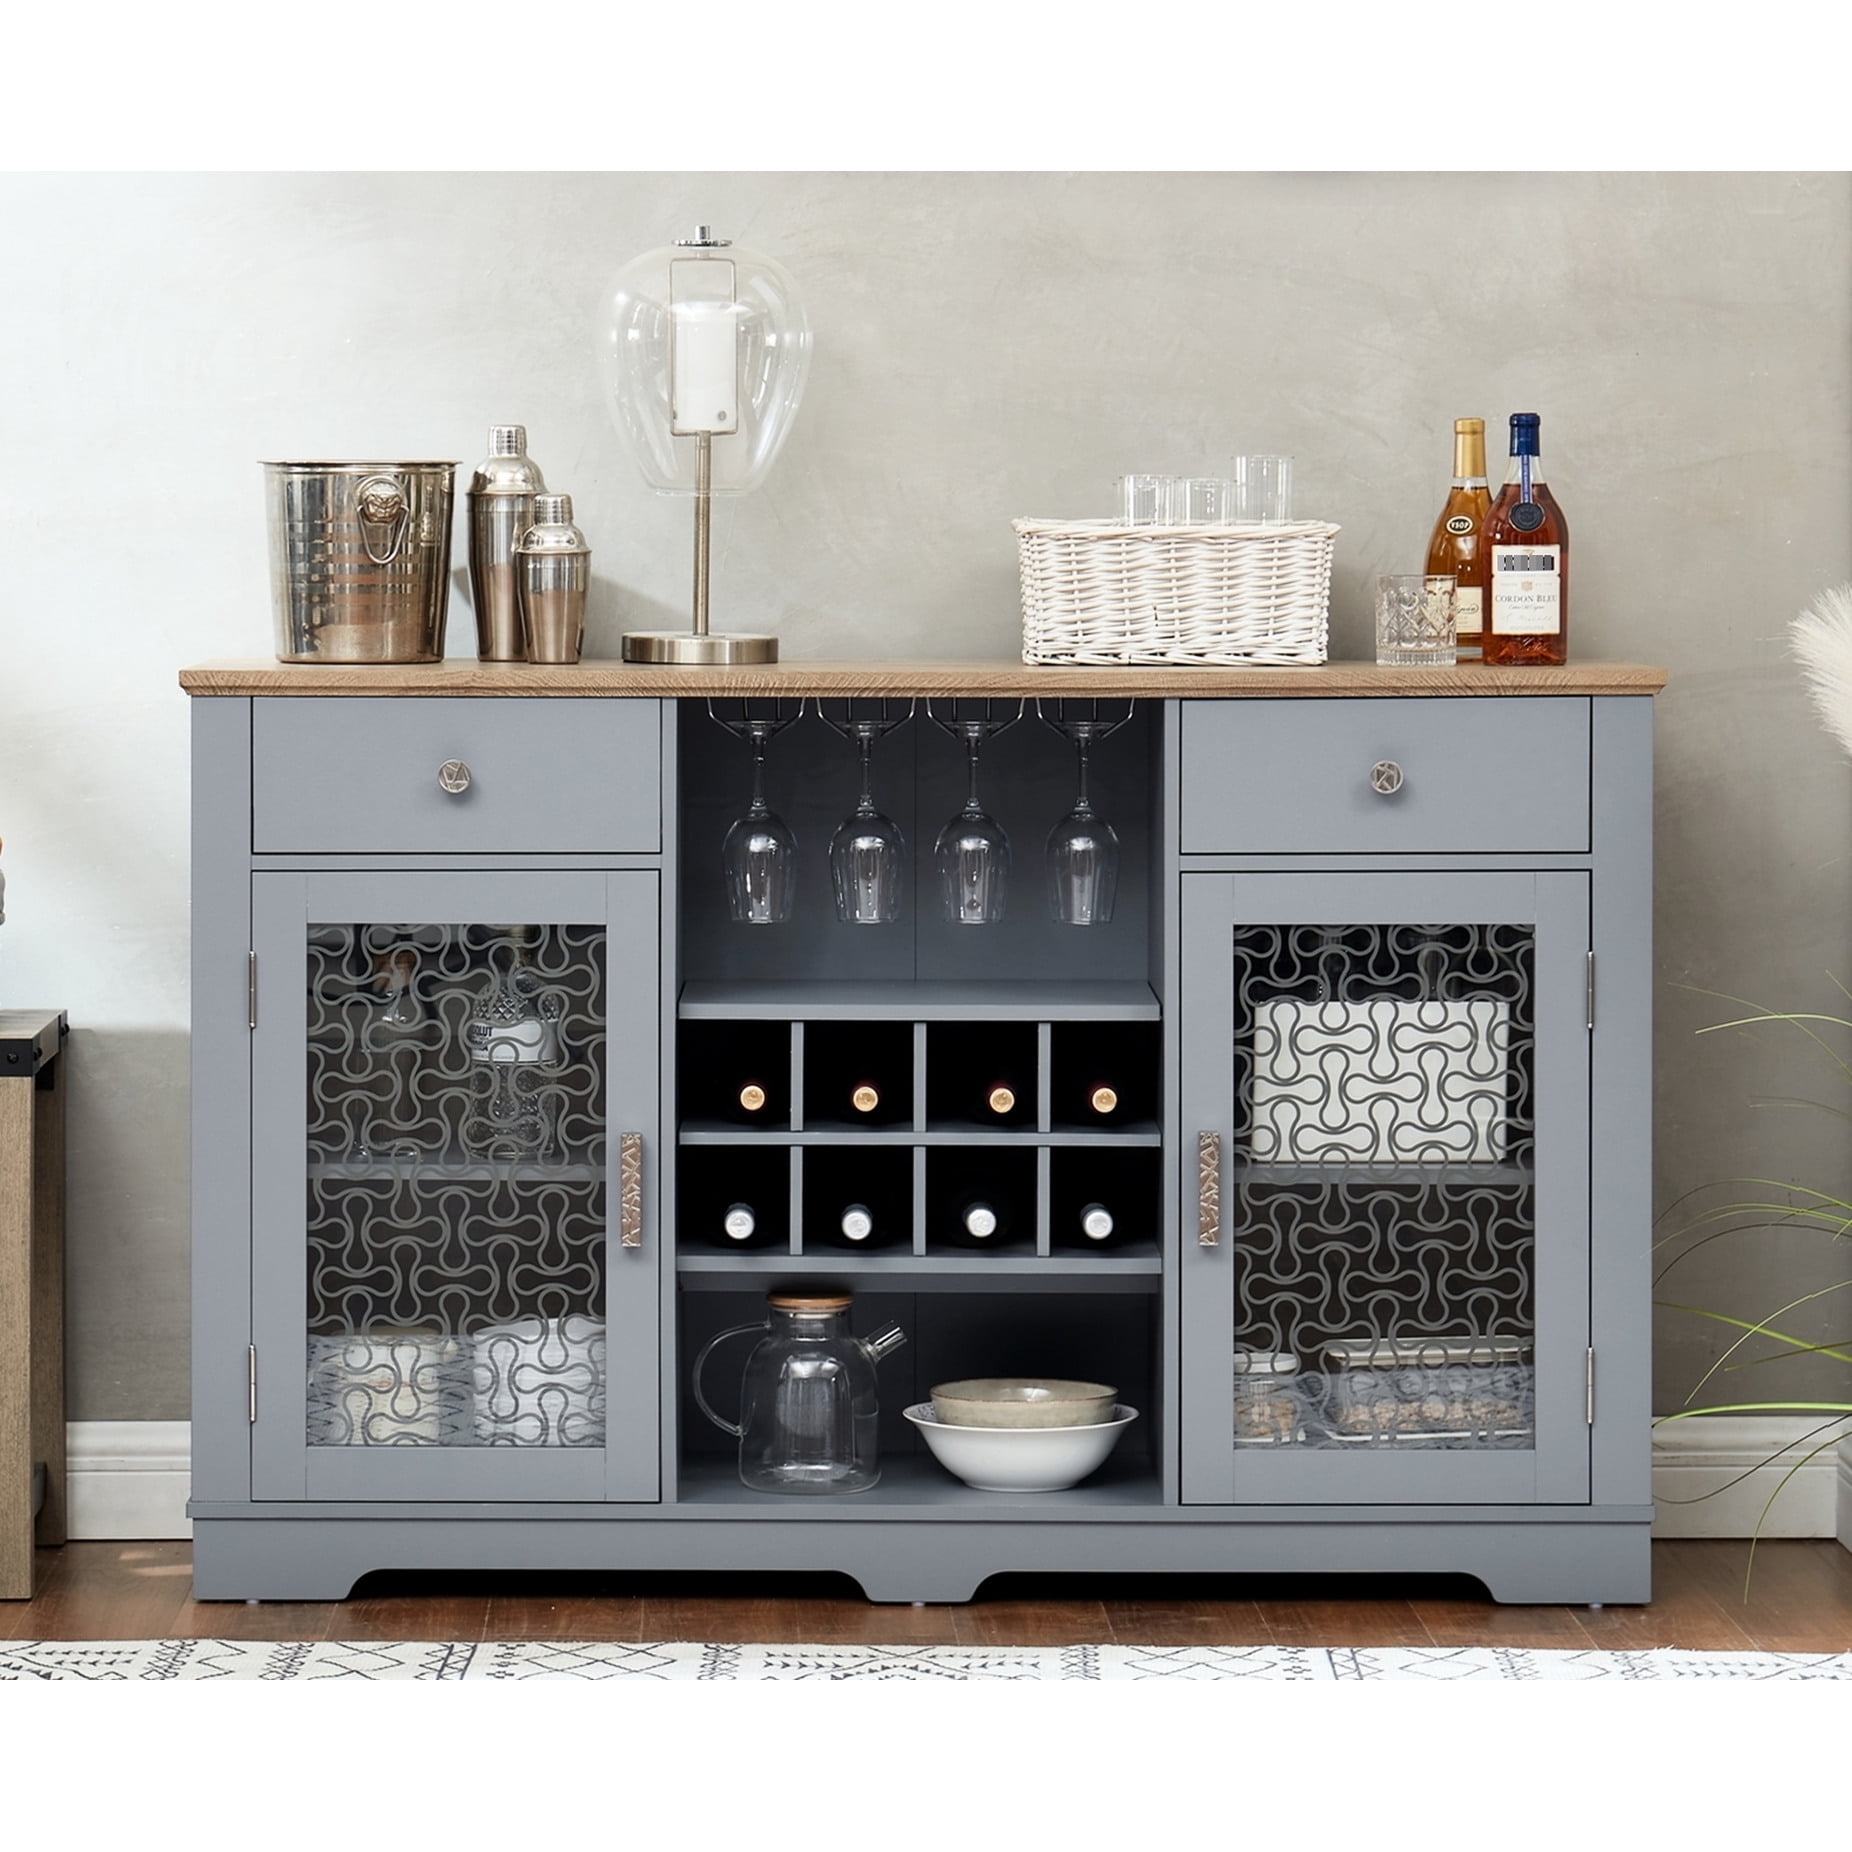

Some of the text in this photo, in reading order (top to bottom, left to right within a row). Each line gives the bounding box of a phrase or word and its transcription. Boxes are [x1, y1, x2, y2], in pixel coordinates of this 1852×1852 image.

[1451, 521, 1469, 529] VSOP
[1495, 594, 1557, 602] CORDON BLEU
